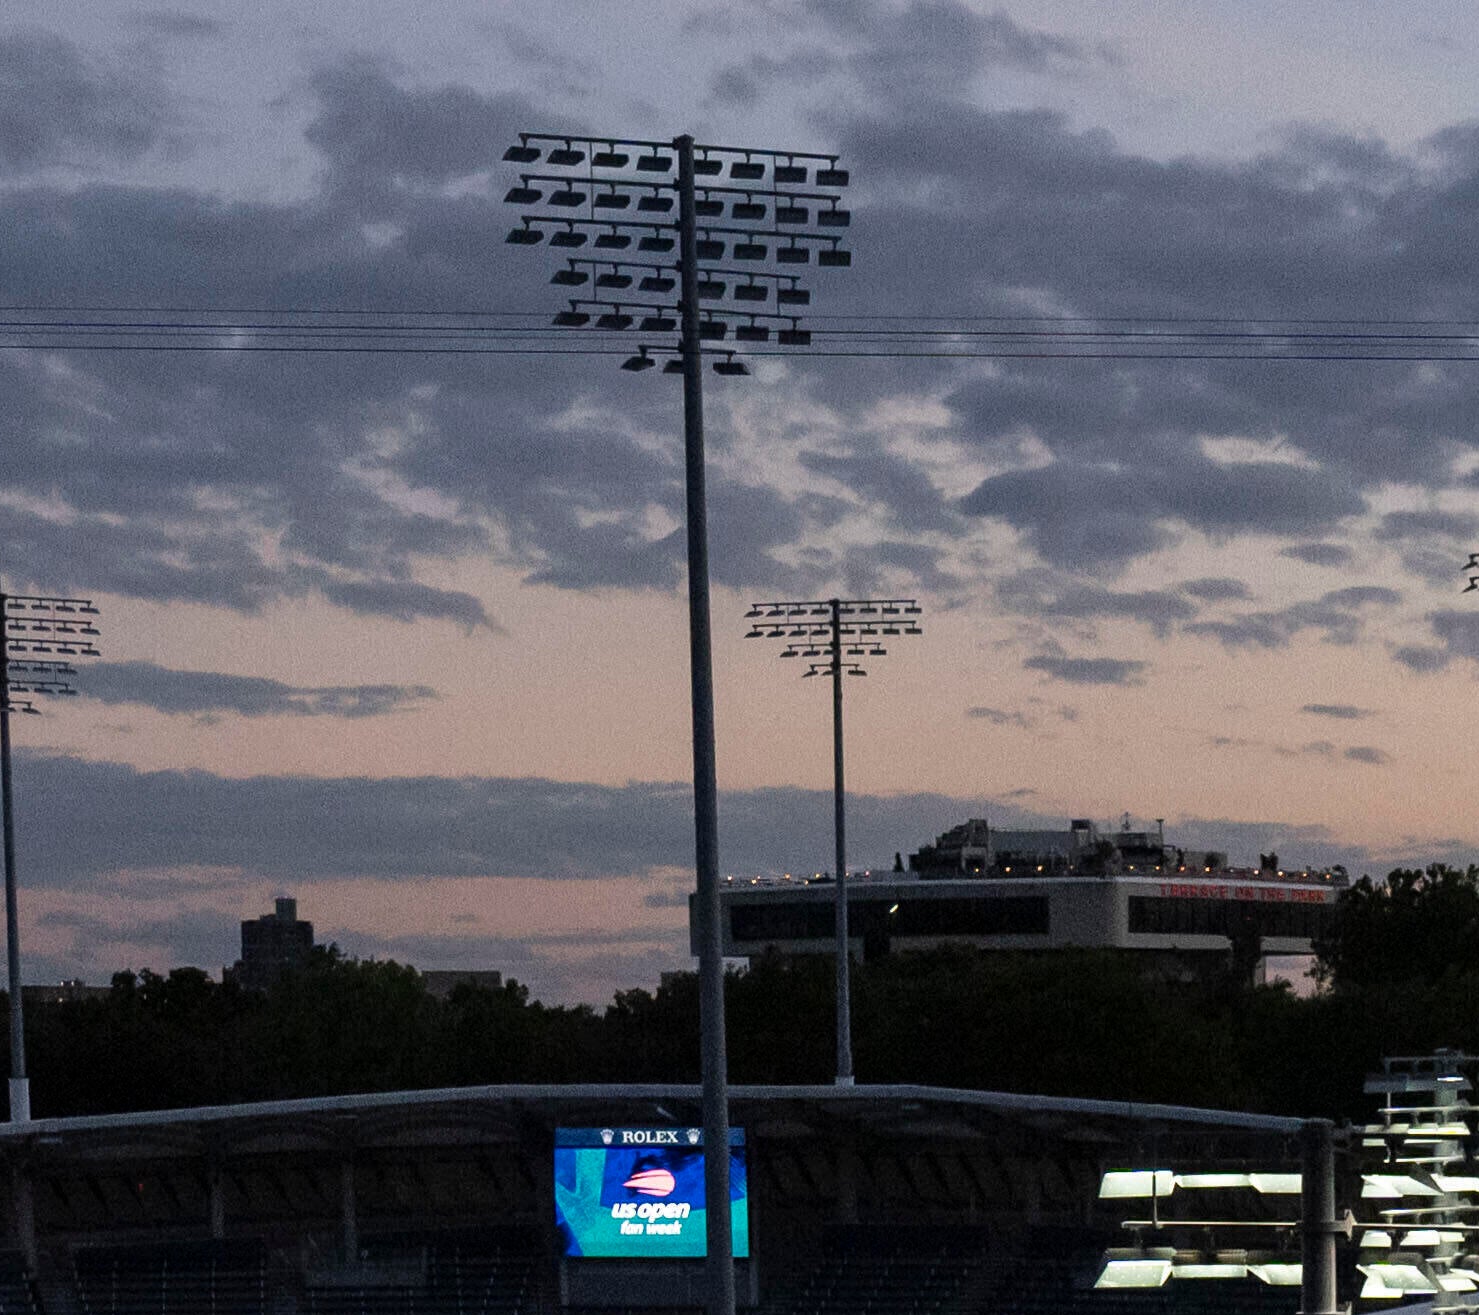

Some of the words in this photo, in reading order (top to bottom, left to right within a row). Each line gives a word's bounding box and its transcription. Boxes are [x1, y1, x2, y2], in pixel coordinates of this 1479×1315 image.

[622, 1130, 679, 1144] ROLEX
[611, 1202, 636, 1219] us
[637, 1202, 691, 1224] open
[620, 1220, 644, 1235] fan
[646, 1220, 682, 1235] week
